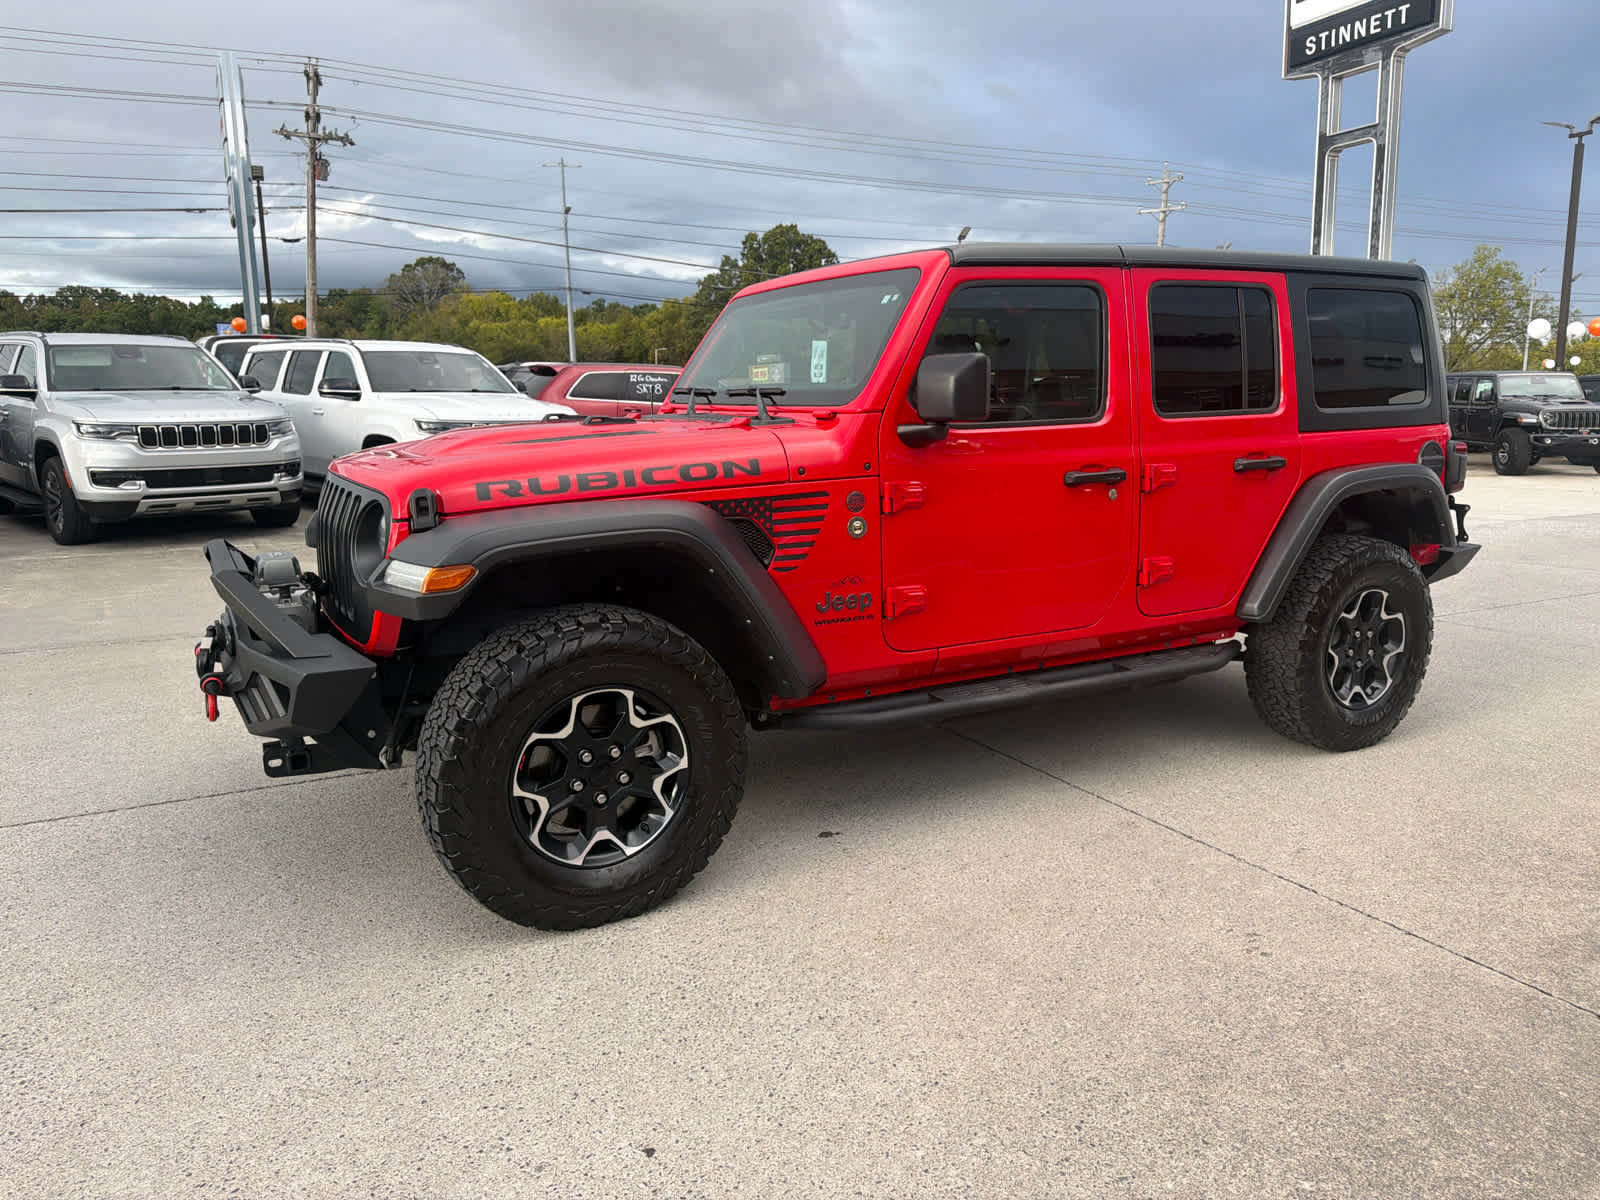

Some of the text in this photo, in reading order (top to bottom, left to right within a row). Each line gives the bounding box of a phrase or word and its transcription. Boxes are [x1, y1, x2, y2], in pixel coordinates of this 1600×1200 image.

[1305, 4, 1410, 55] STINNETT
[475, 458, 762, 501] RUBICON
[816, 591, 872, 613] Jeep
